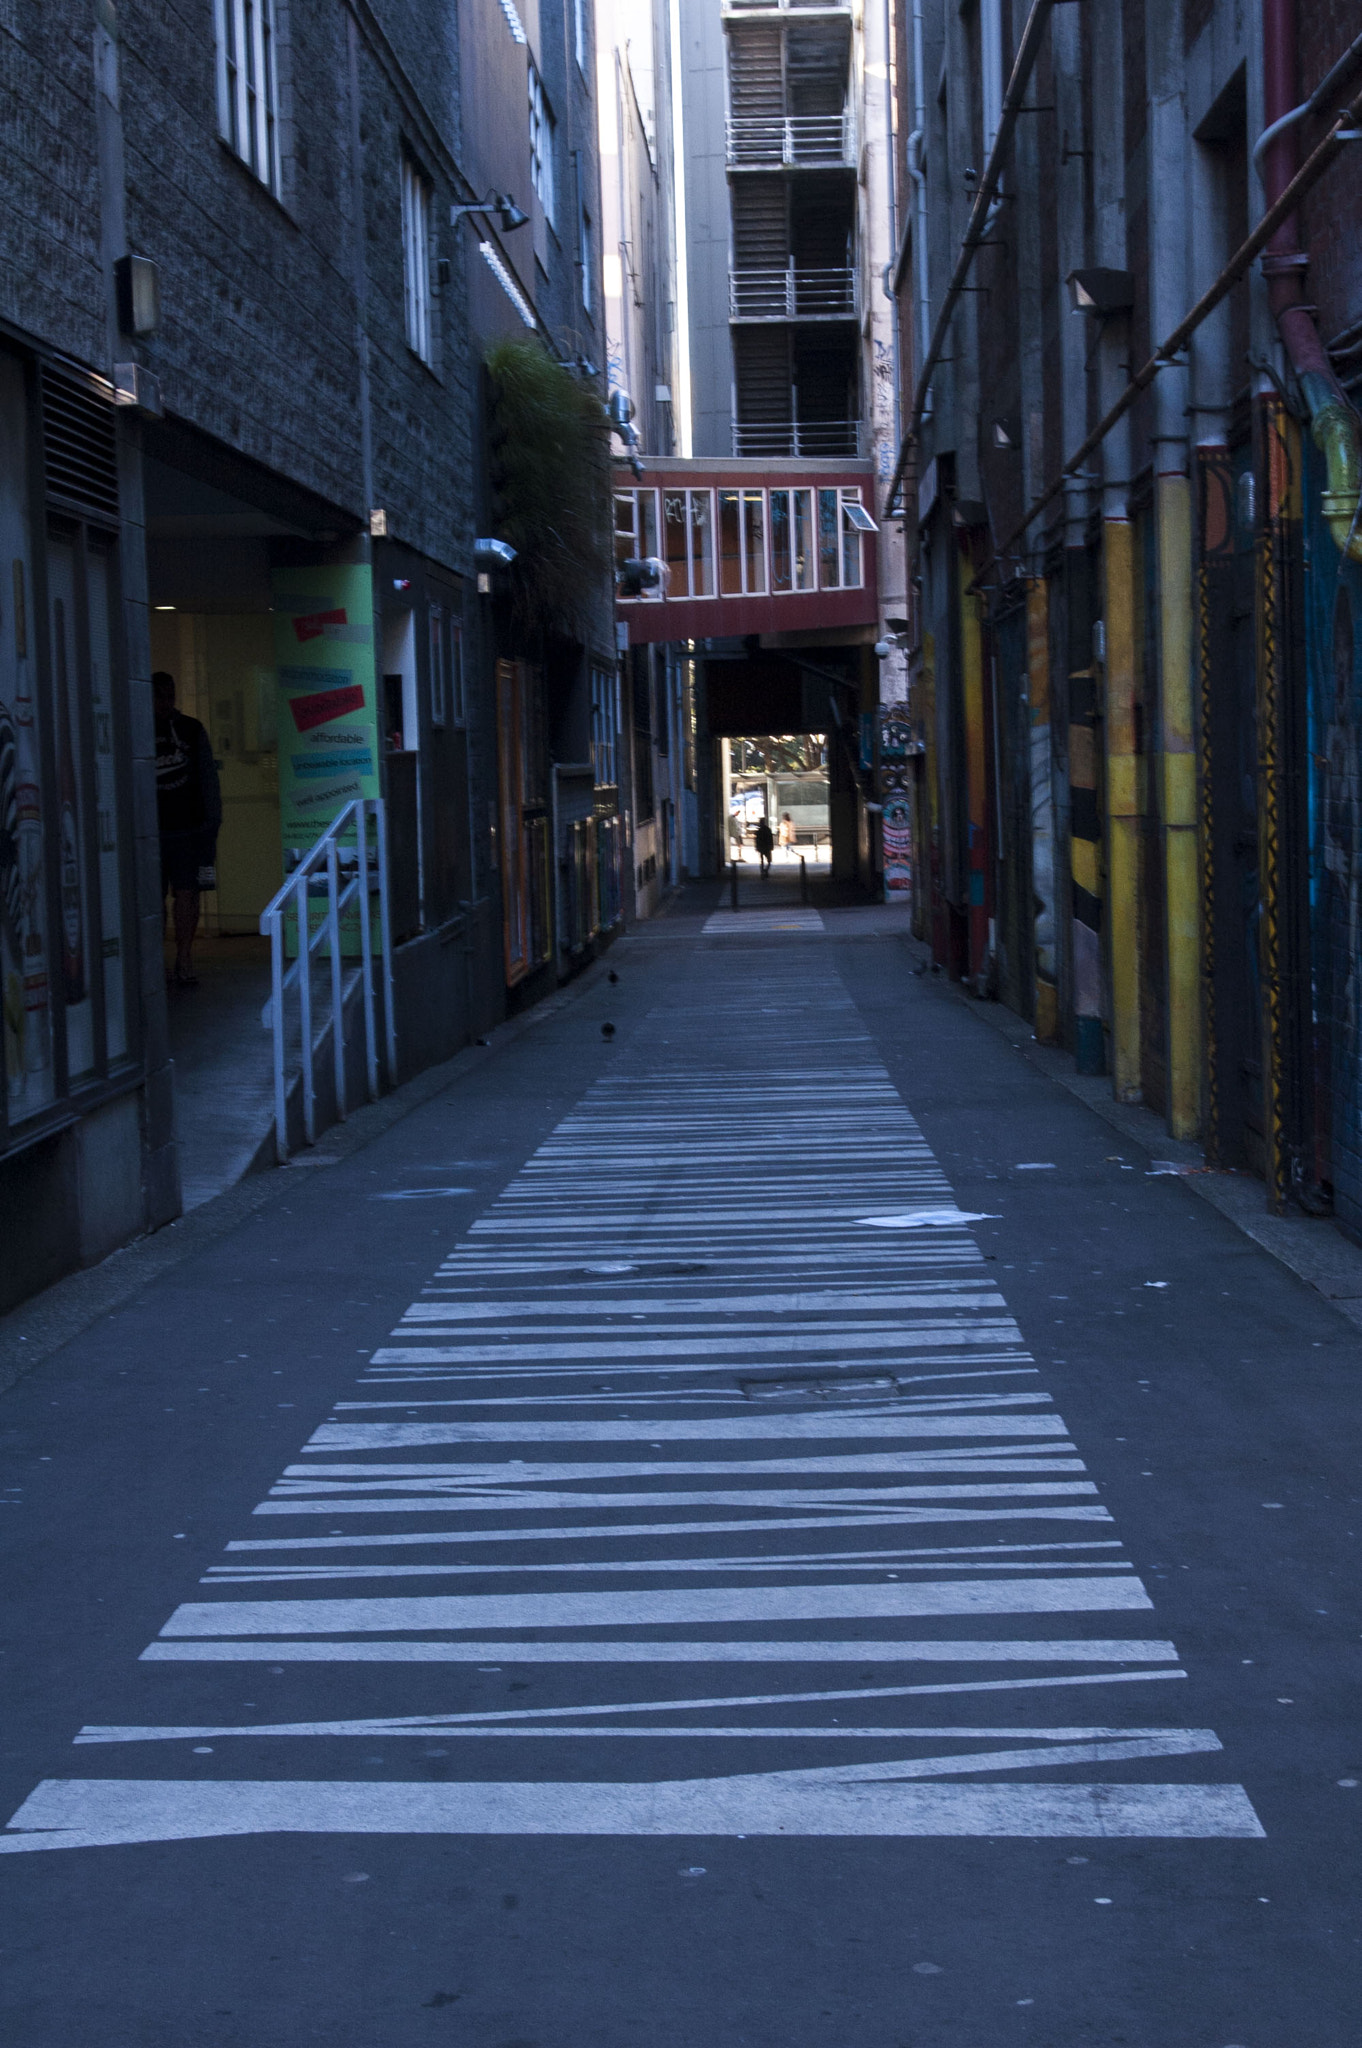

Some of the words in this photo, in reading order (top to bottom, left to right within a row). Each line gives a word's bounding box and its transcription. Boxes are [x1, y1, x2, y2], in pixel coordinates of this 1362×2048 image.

[310, 732, 364, 744] affordable
[339, 756, 372, 766] location
[296, 794, 314, 807] well
[315, 782, 359, 801] appointed
